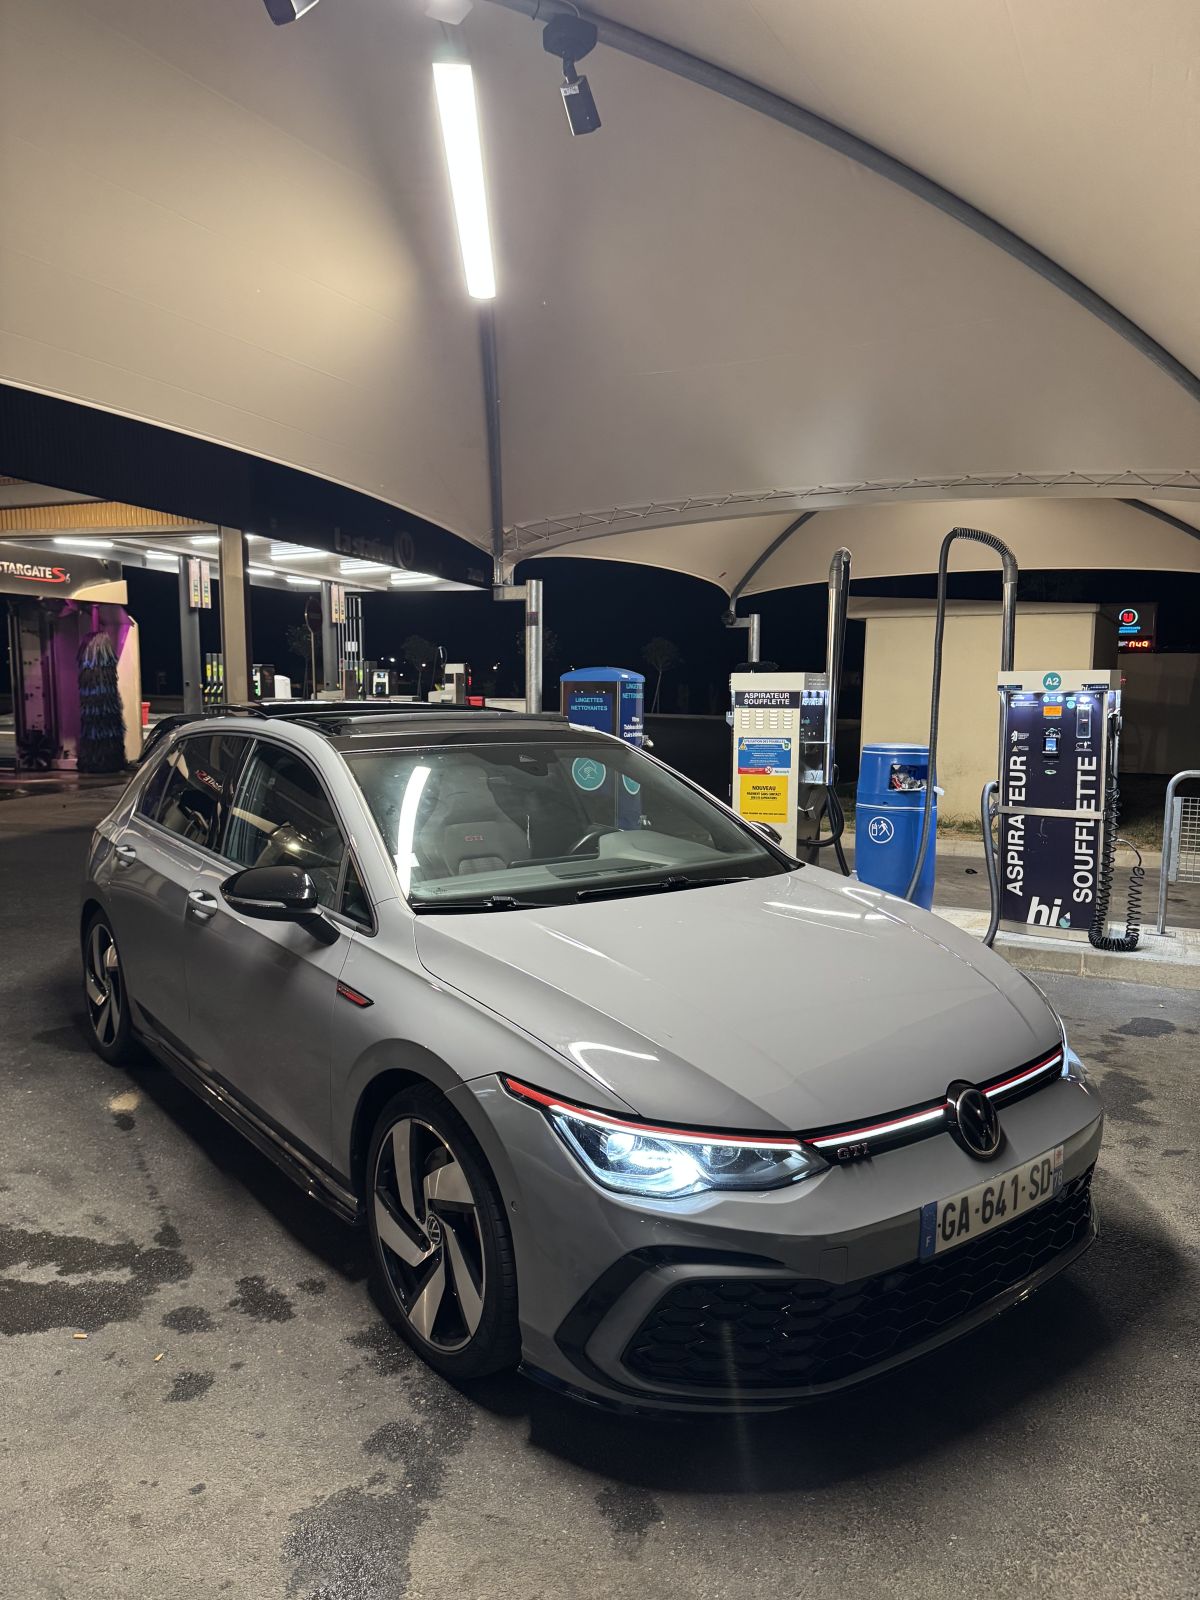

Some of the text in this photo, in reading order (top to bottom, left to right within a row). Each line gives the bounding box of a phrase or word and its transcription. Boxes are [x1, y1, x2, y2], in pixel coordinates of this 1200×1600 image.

[1045, 677, 1060, 686] A2
[1072, 756, 1097, 903] SOUFFLETTE
[838, 1142, 867, 1160] GTI
[925, 1235, 931, 1248] F
[941, 1158, 1051, 1241] GA-641-SD
